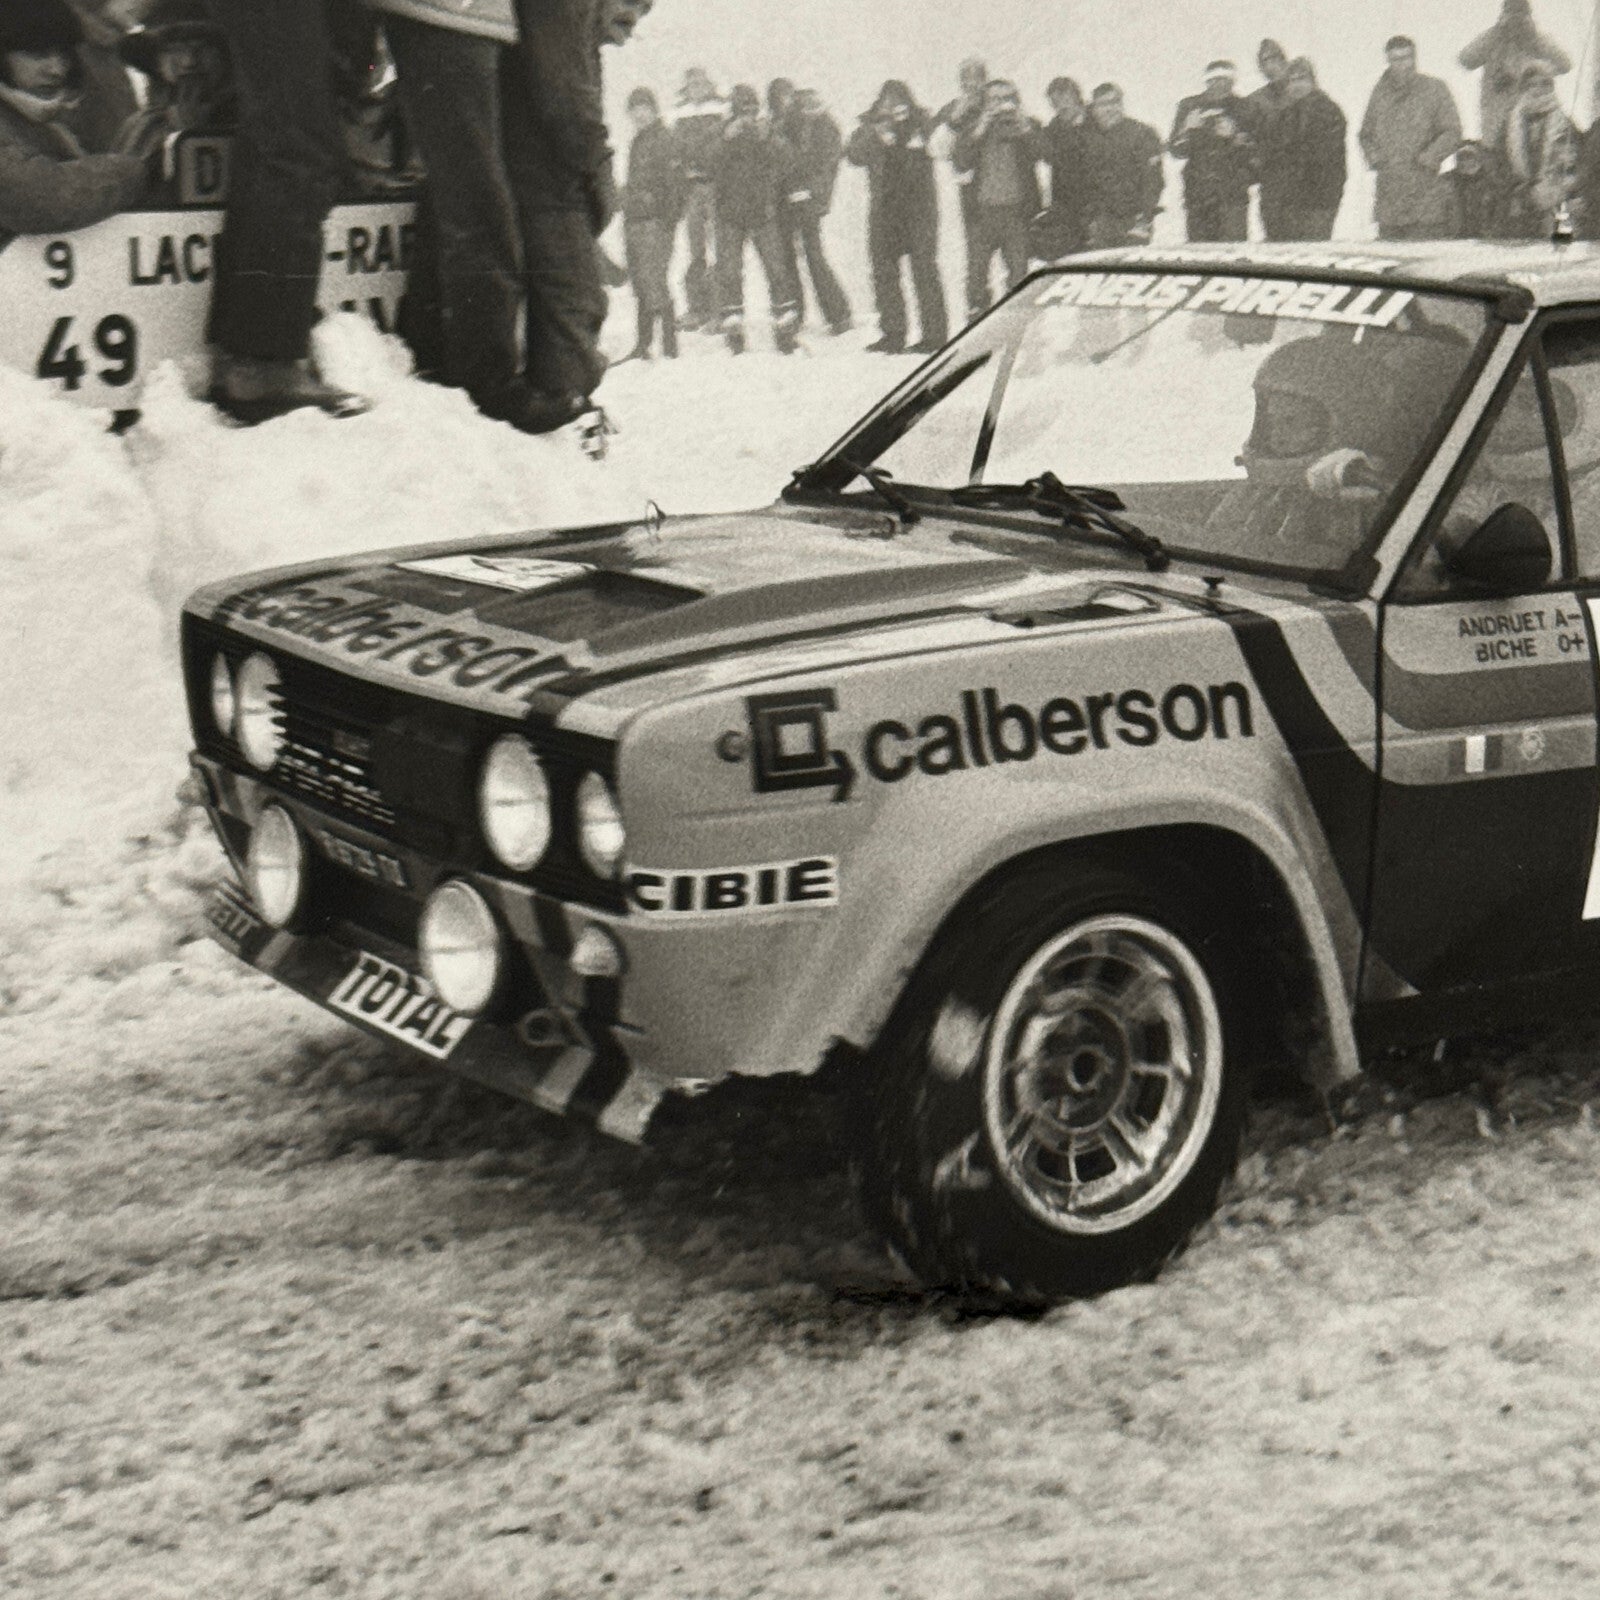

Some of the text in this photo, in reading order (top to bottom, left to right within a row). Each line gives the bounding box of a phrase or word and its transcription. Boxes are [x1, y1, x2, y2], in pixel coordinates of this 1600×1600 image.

[45, 240, 75, 290] 9
[128, 233, 219, 286] LAC
[1036, 273, 1414, 327] PNEUS PIRELLI
[36, 313, 138, 391] 49
[238, 586, 592, 693] calberson
[1459, 610, 1545, 637] ANDRUET
[1475, 637, 1538, 662] BICHE
[863, 680, 1255, 784] calberson
[629, 860, 834, 912] CIBIE
[341, 957, 464, 1051] TOTAL
